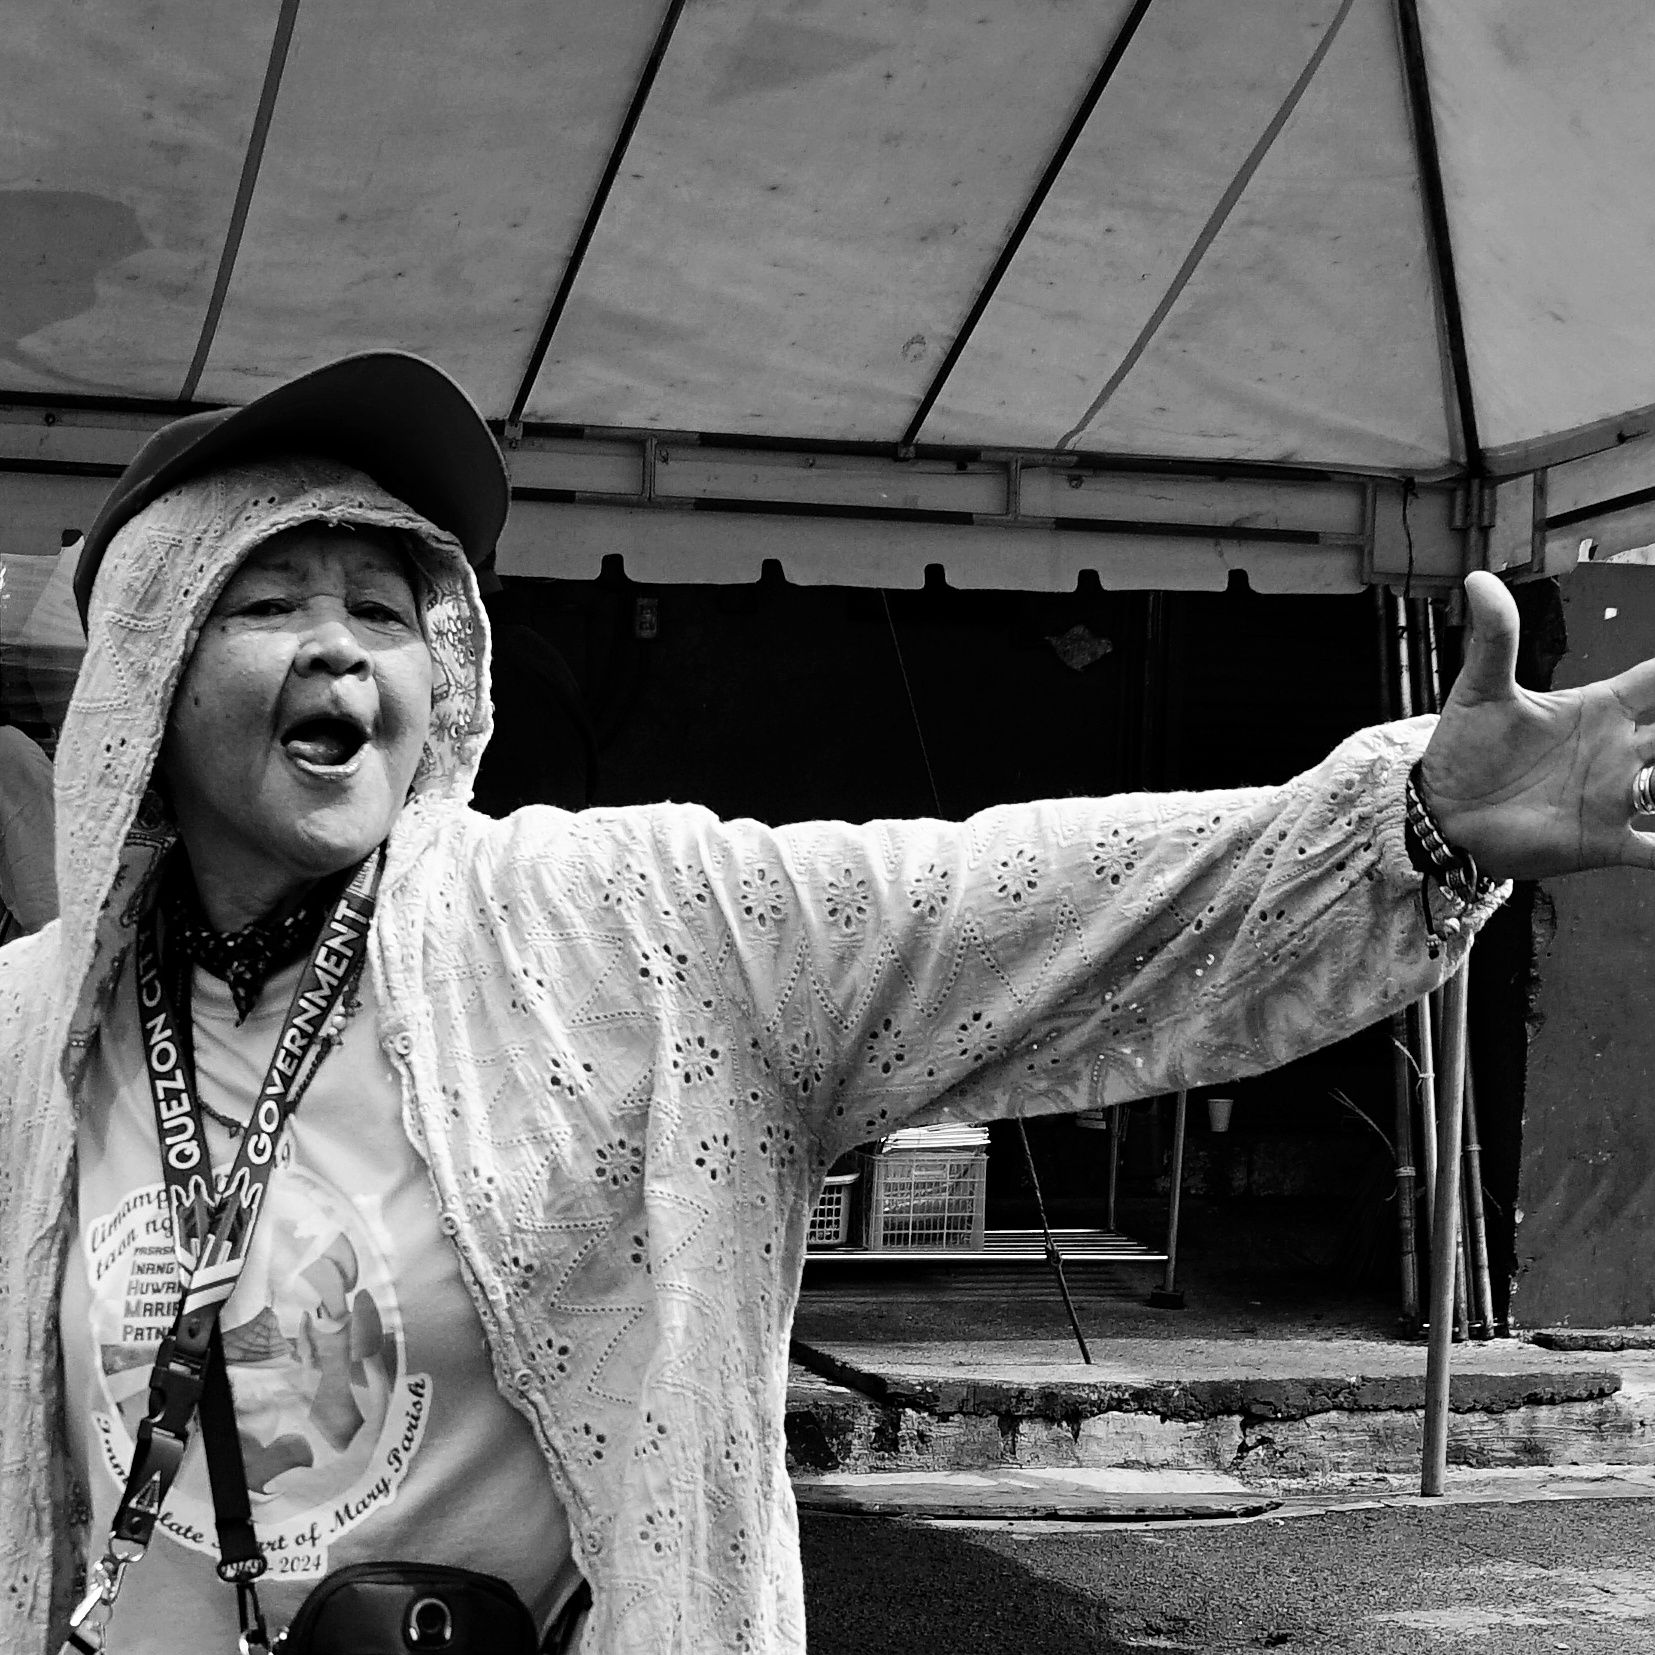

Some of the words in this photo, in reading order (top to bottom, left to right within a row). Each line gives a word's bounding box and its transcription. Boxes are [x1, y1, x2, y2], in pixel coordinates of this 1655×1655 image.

[247, 899, 368, 1165] GOVERNMENT
[145, 1012, 201, 1170] QUEZON
[131, 1260, 174, 1276] INANG
[122, 1325, 171, 1342] PATN
[294, 1522, 321, 1547] of
[330, 1476, 391, 1533] Mary
[387, 1378, 426, 1473] Parish
[279, 1554, 321, 1574] 2024
